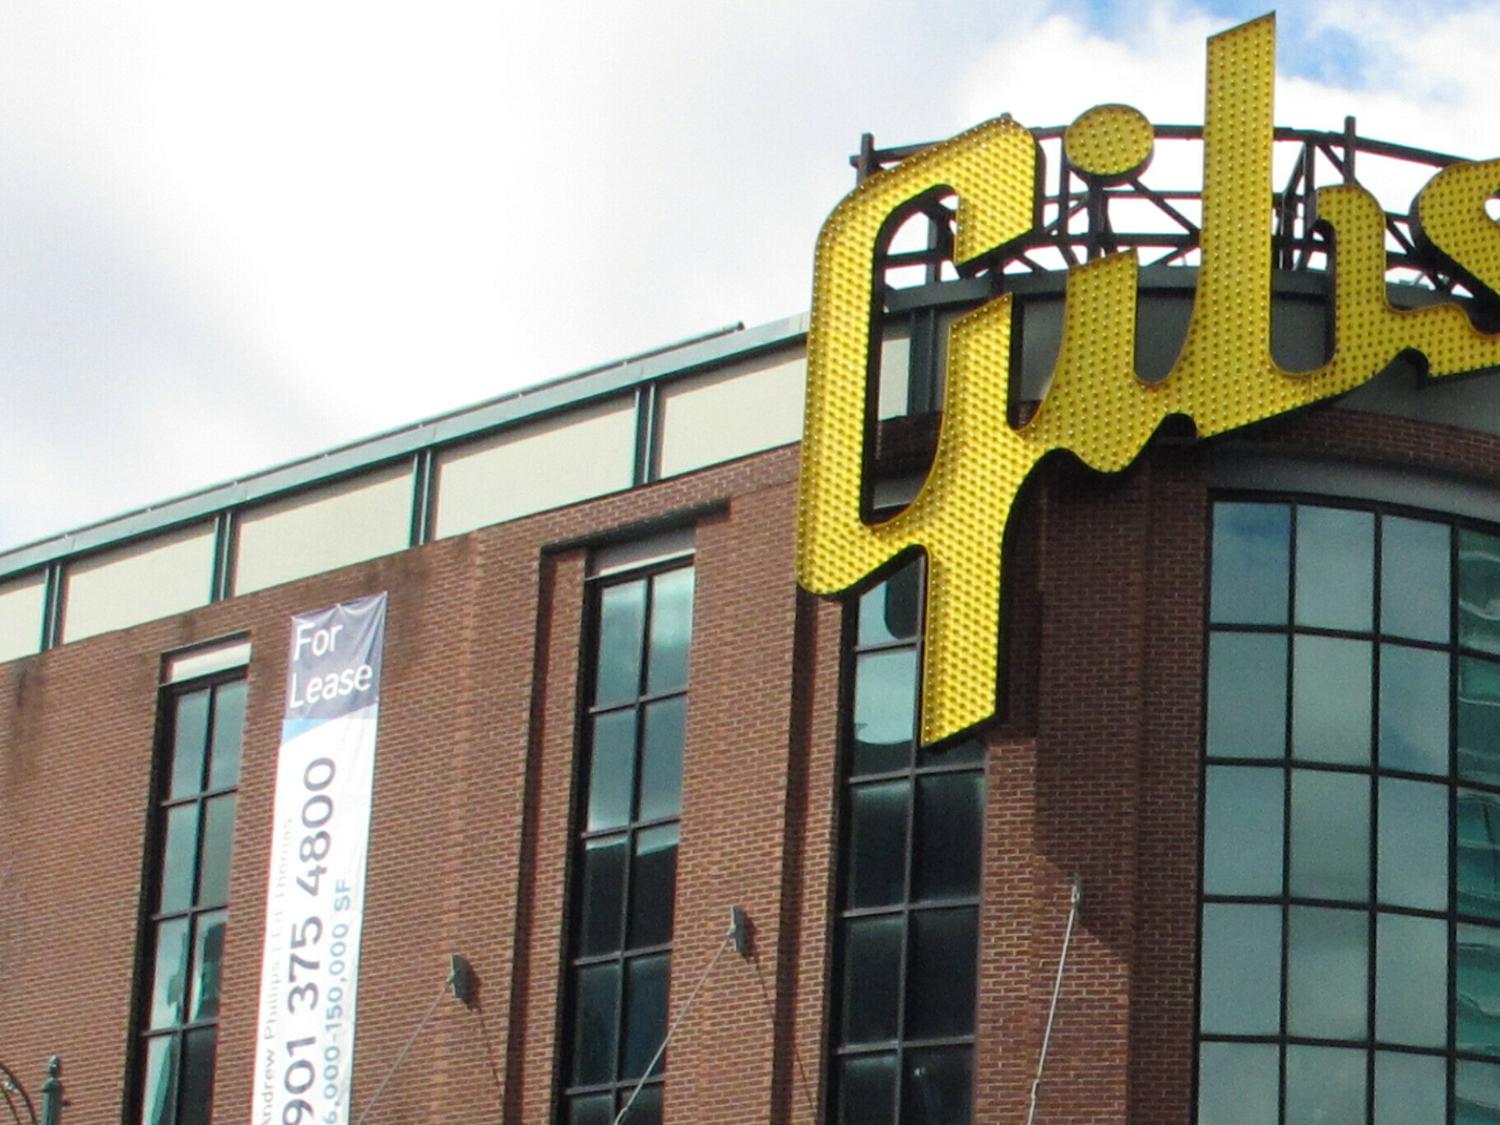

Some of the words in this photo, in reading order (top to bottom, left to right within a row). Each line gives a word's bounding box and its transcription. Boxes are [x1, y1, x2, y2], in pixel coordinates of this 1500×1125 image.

[293, 620, 344, 662] For
[289, 664, 373, 709] Lease
[296, 757, 336, 896] 4800
[334, 879, 354, 913] SF
[287, 916, 323, 1014] 375
[322, 923, 350, 1125] 6,000-150,000
